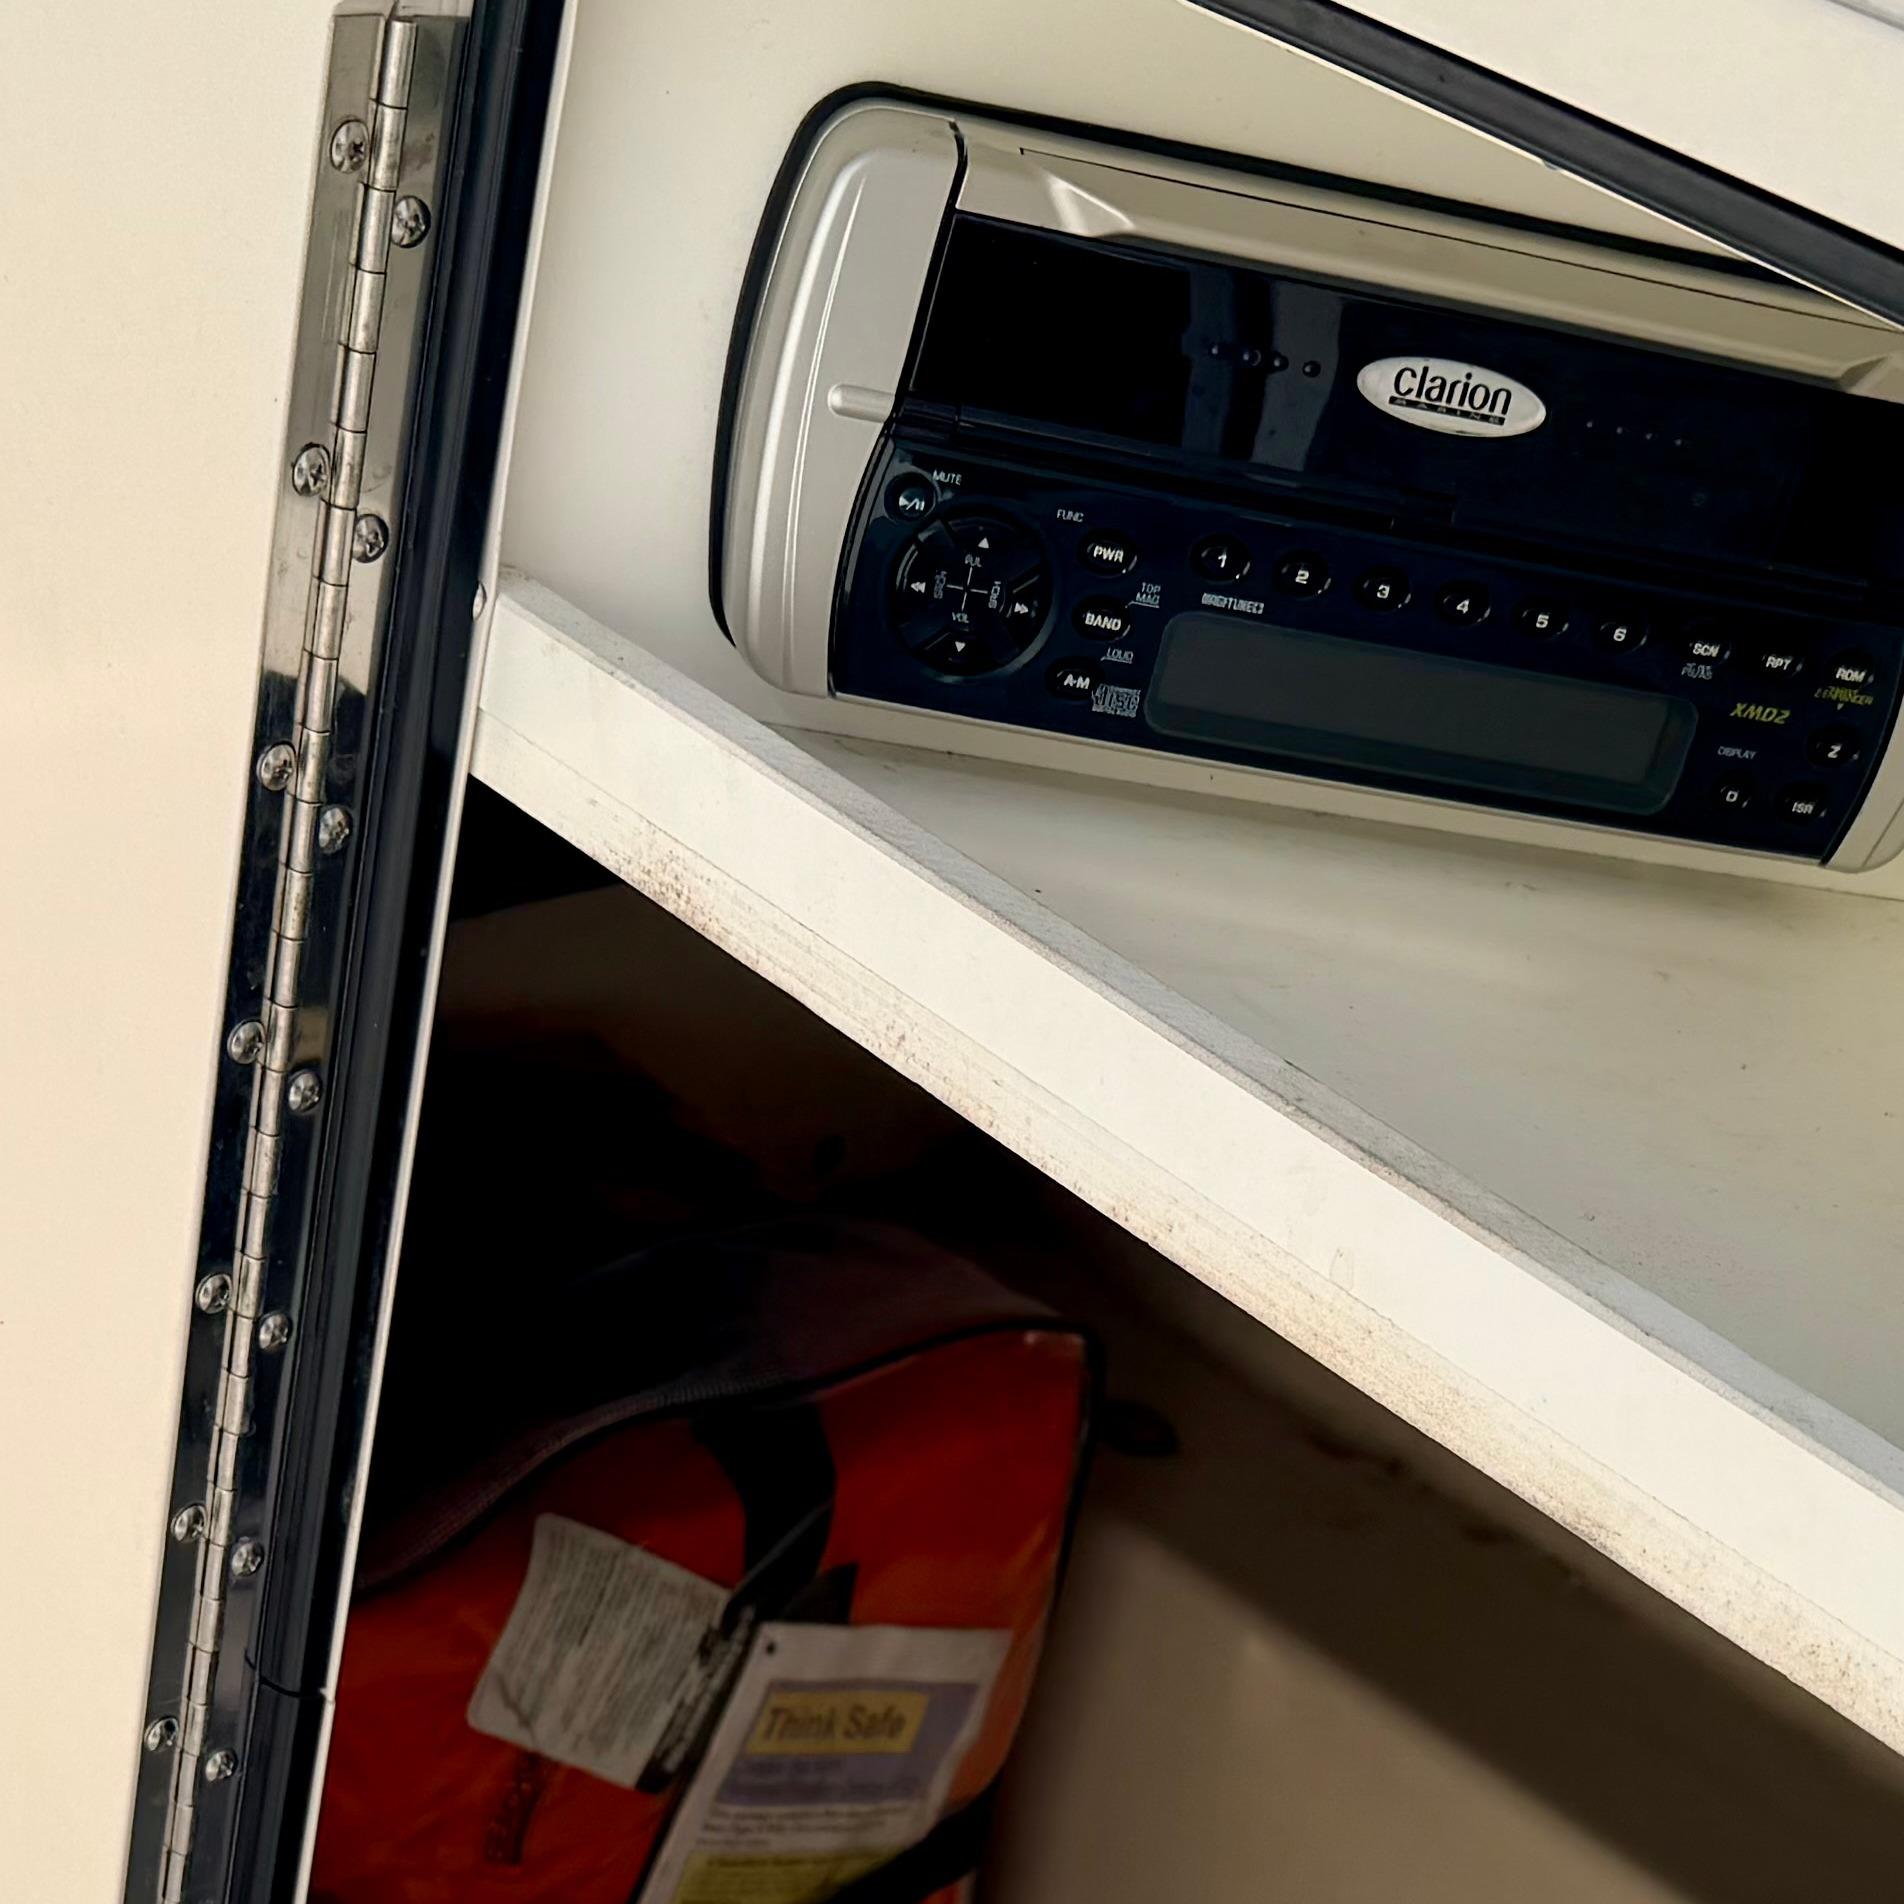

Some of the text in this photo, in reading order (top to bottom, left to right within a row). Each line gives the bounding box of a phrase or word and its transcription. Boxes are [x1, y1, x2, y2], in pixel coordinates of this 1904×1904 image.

[933, 469, 962, 485] MUTE
[1092, 545, 1124, 564] PWR
[1217, 553, 1627, 642] 1 2 3 4 5 6
[1084, 612, 1122, 631] BAND
[1692, 643, 1721, 657] SCN
[1765, 656, 1791, 670] RPT
[1827, 745, 1842, 759] Z
